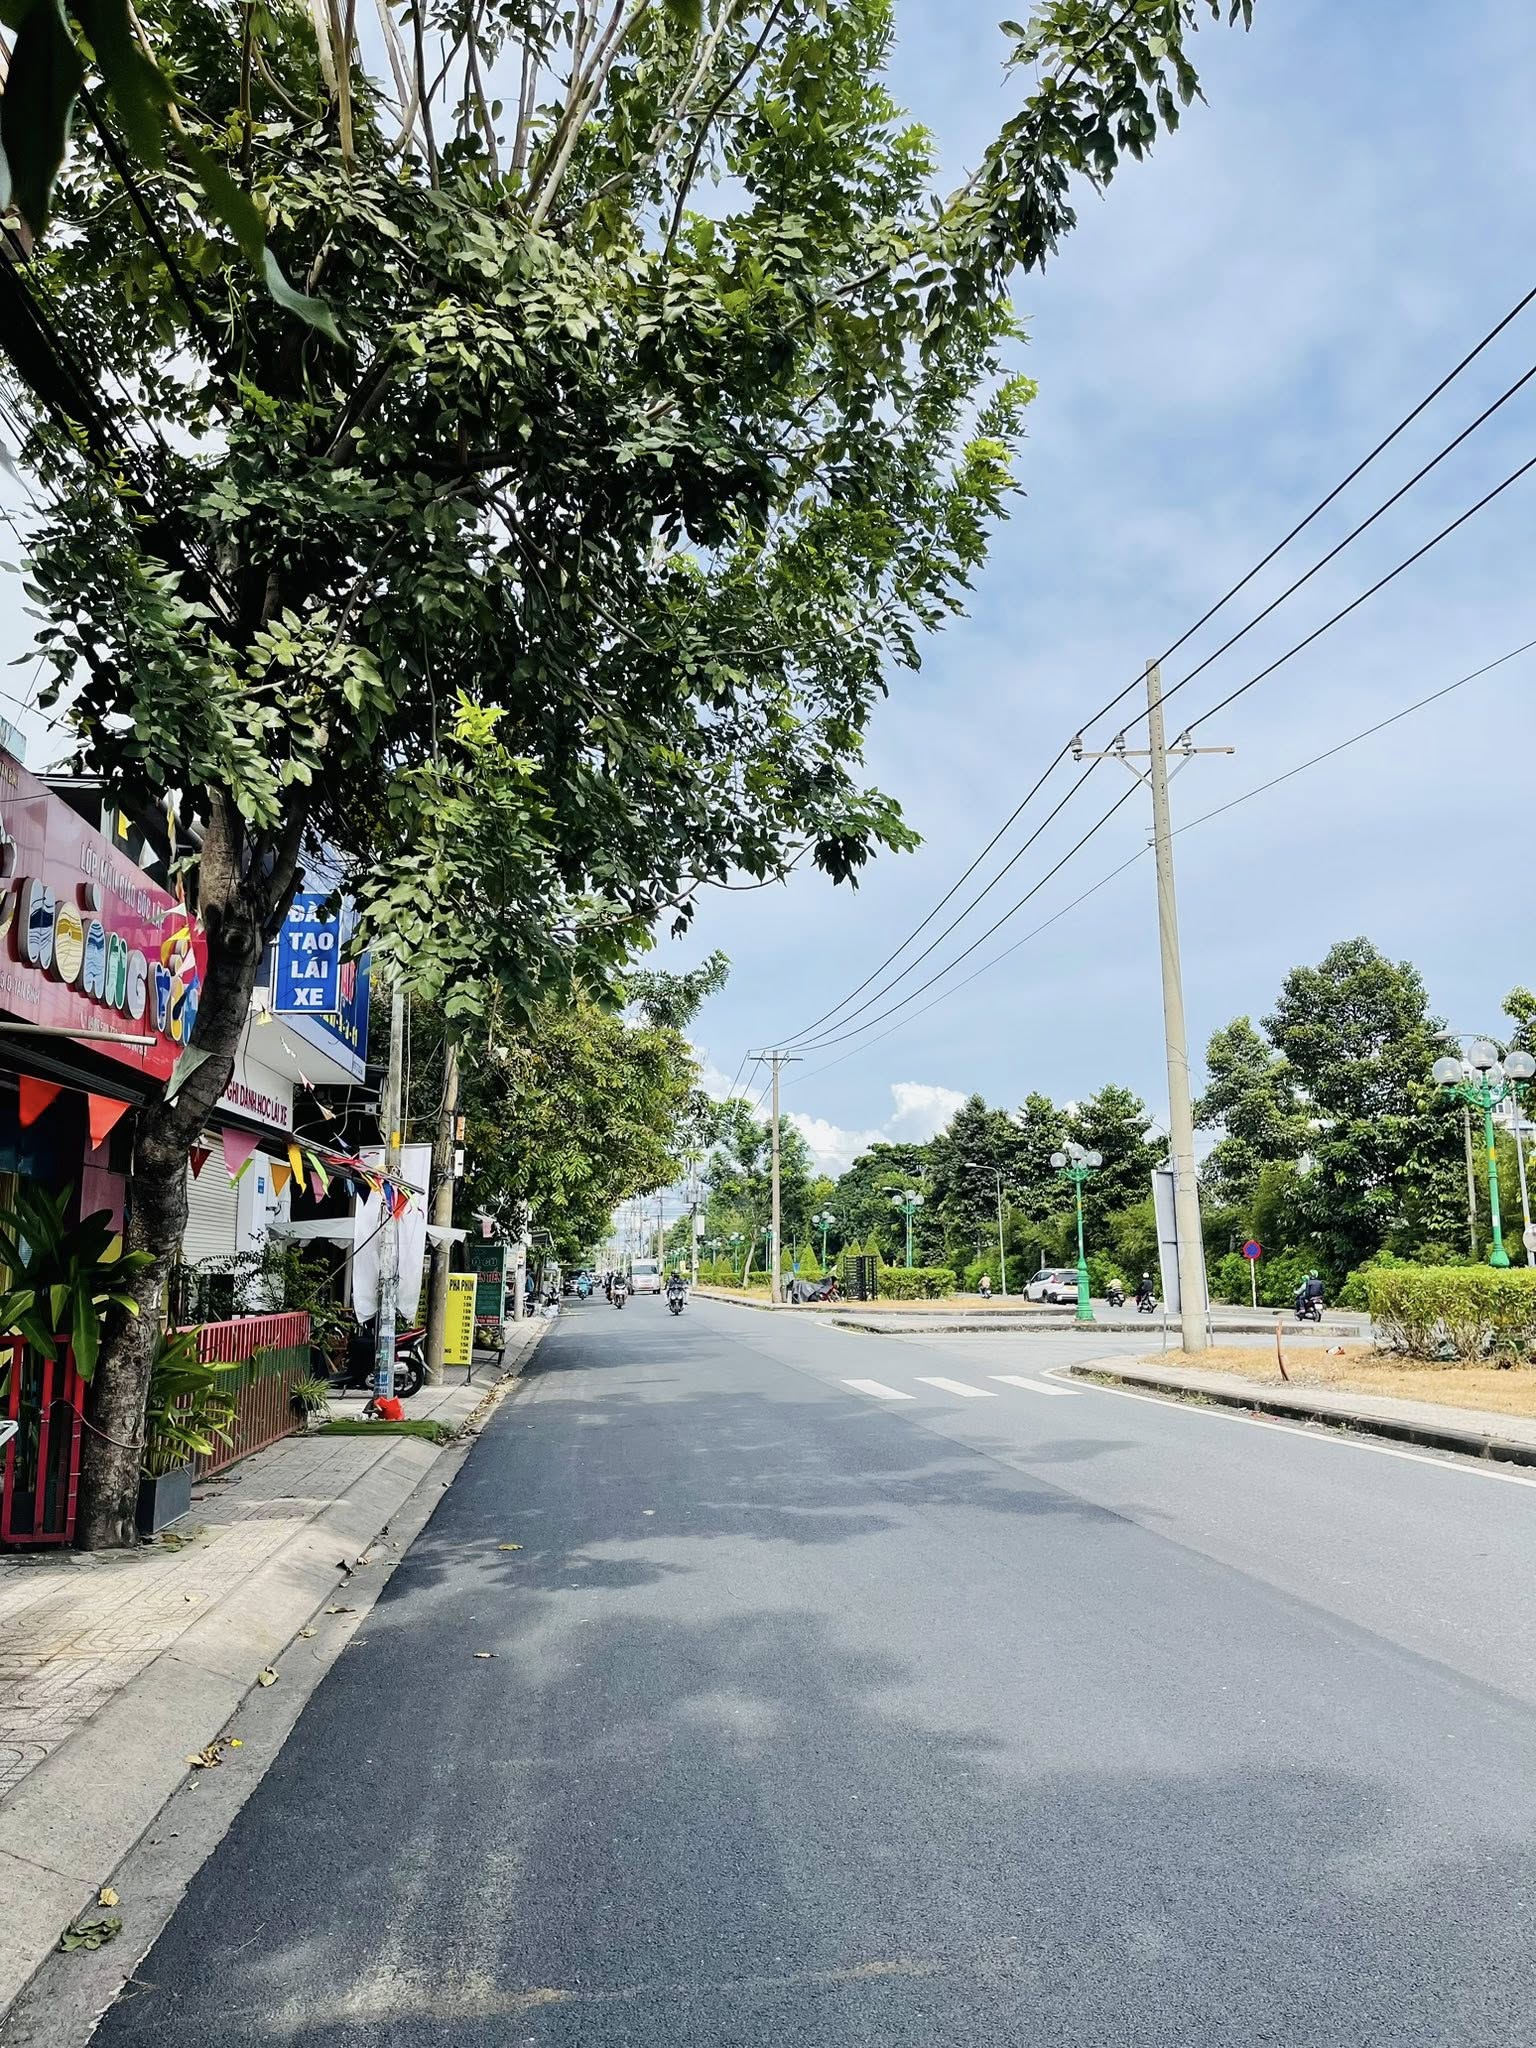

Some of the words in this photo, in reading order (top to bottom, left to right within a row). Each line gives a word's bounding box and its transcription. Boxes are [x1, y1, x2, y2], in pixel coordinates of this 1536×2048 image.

[82, 841, 97, 877] LỚP
[289, 932, 334, 954] TẠO
[291, 957, 328, 978] LÁI
[294, 988, 324, 1006] XE
[226, 1081, 239, 1104] GHI
[240, 1085, 257, 1112] DANH
